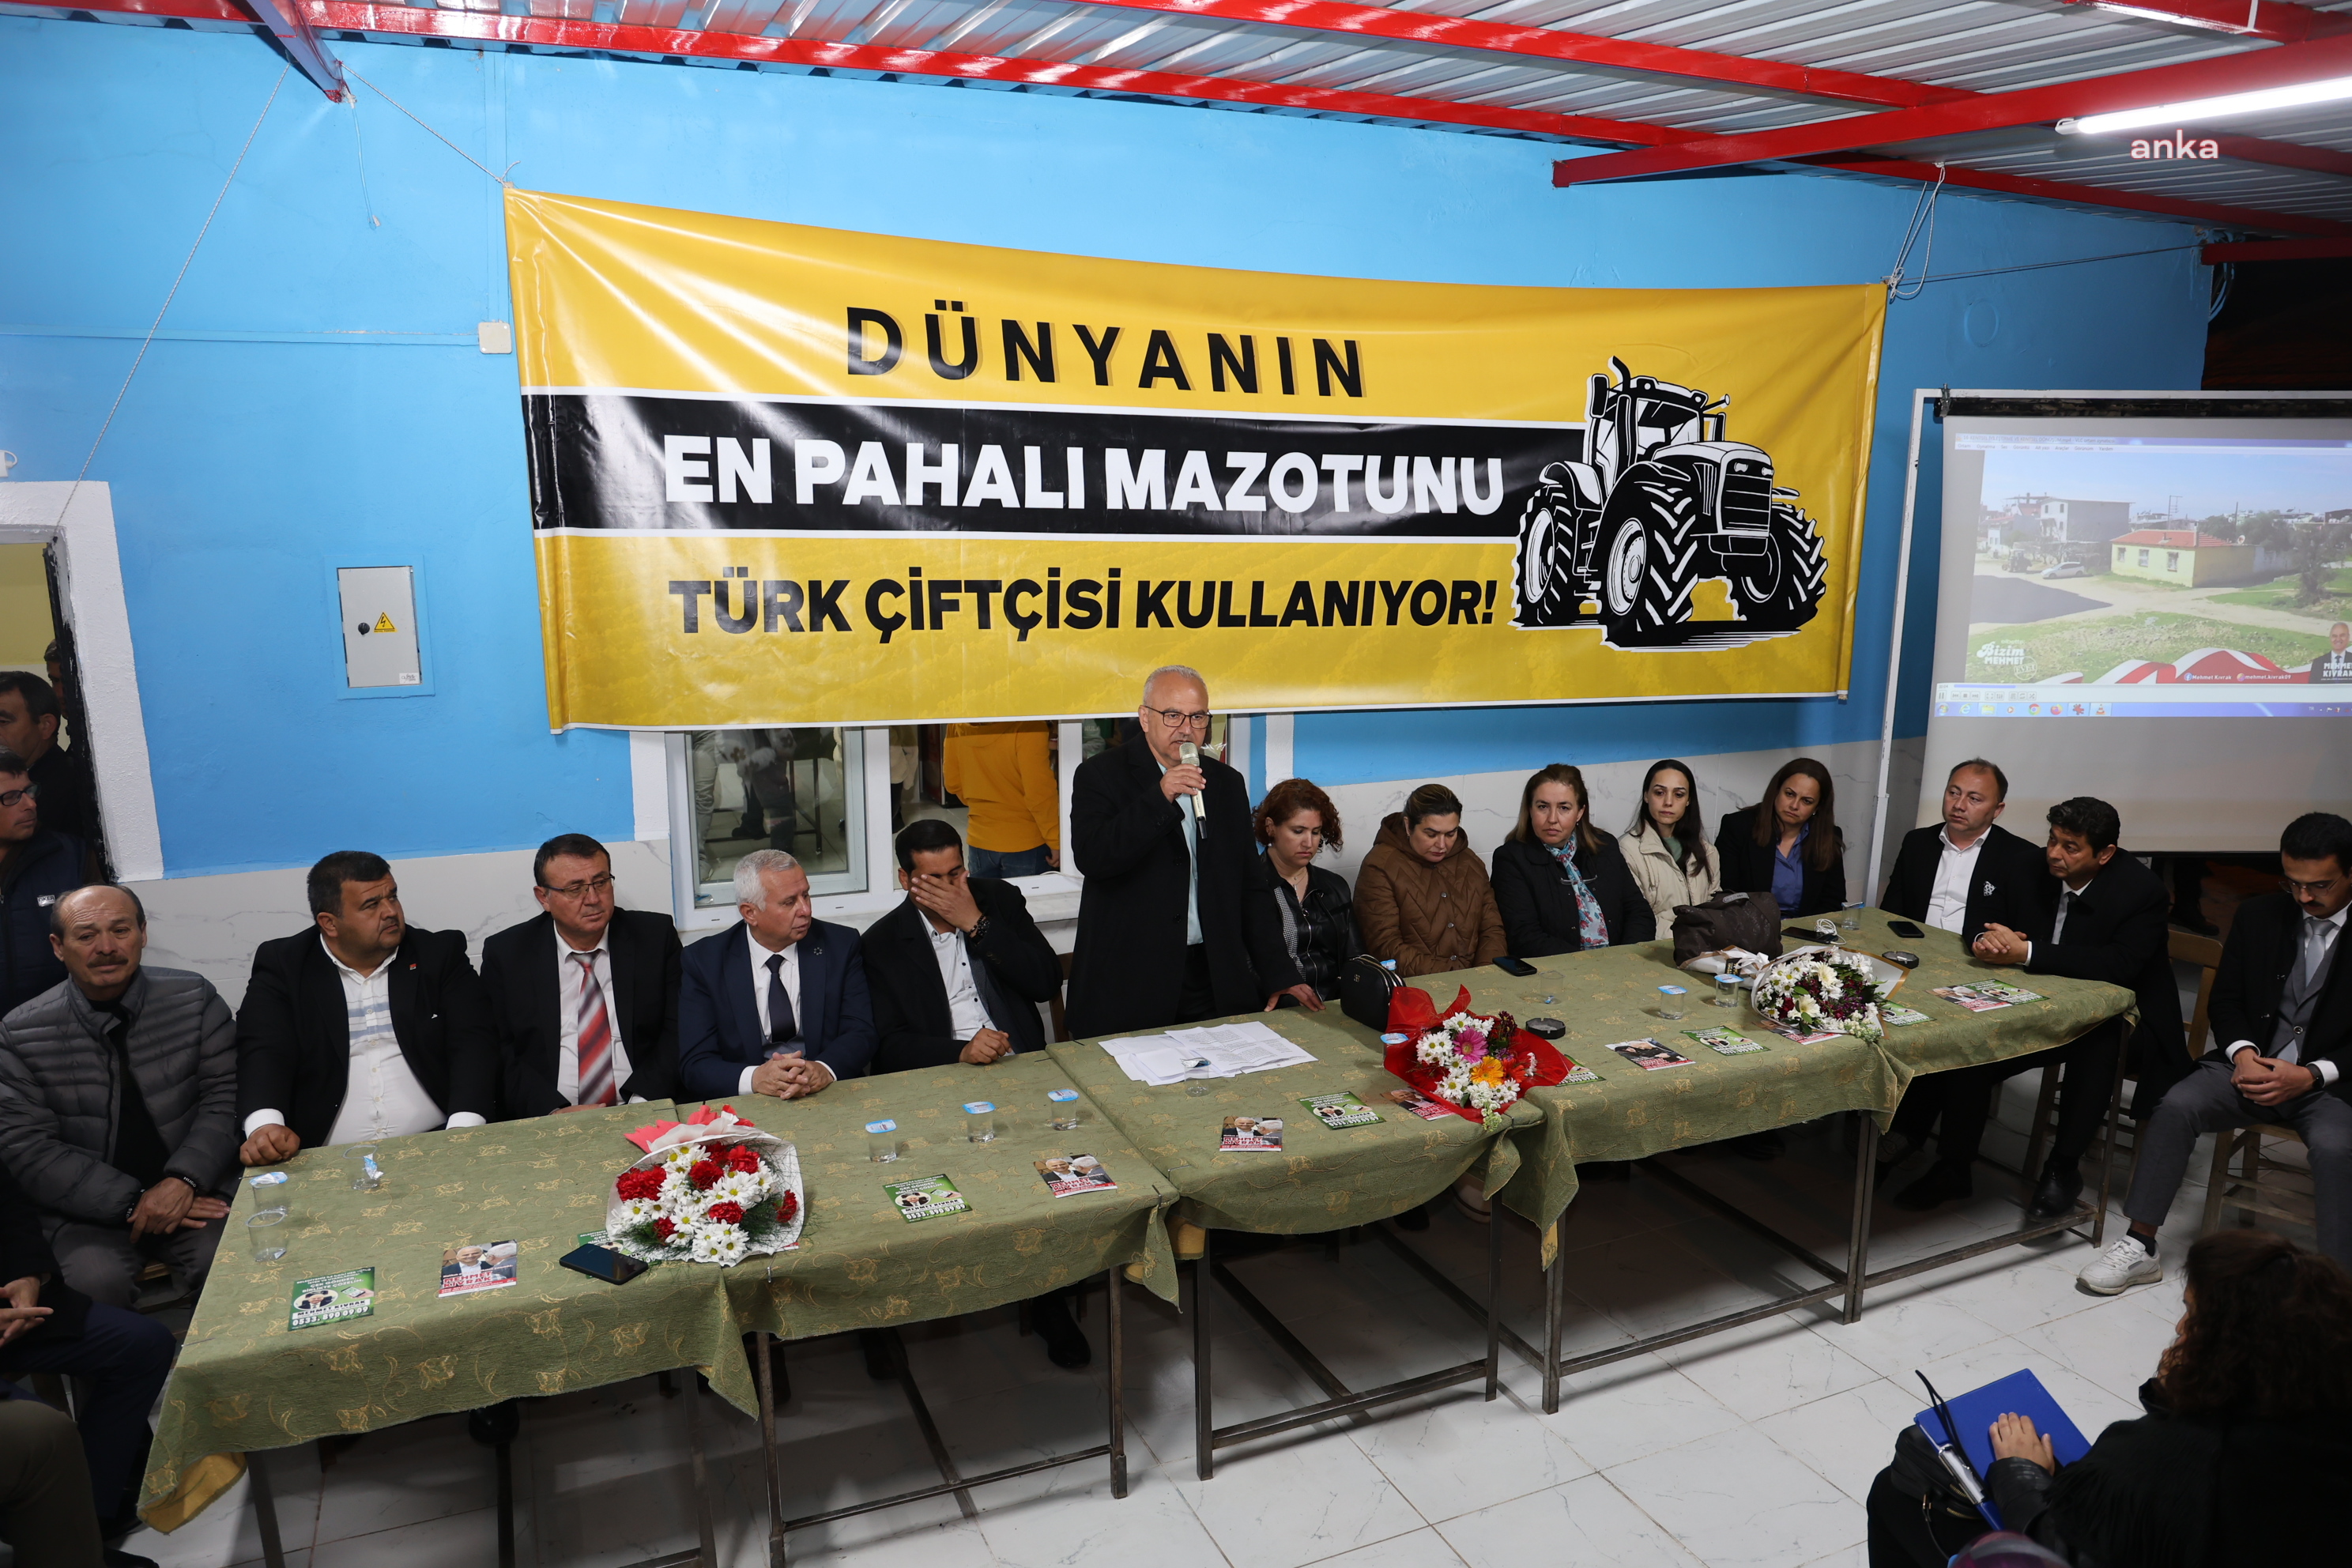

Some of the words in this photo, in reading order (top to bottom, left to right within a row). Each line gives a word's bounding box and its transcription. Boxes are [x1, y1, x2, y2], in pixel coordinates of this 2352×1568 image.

[847, 300, 1366, 398] DÜNYANIN
[664, 435, 773, 504] EN
[794, 439, 1086, 510] PAHALI
[1105, 447, 1503, 515] MAZOTUNU
[668, 567, 852, 634] TÜRK
[865, 566, 1121, 644] ÇİFTÇİSİ
[1136, 579, 1498, 629] KULLANIYOR!
[1977, 641, 2025, 658] Bizim
[1984, 656, 2024, 665] MEHMET
[183, 1177, 196, 1187] HUGO
[1050, 1178, 1090, 1188] MEHMET
[443, 1271, 492, 1283] MEHMET
[443, 1276, 492, 1287] KIVRAK
[297, 1306, 332, 1316] MEHMET
[334, 1300, 365, 1309] KIVRAK
[292, 1317, 320, 1326] 0533.
[322, 1311, 341, 1320] 890
